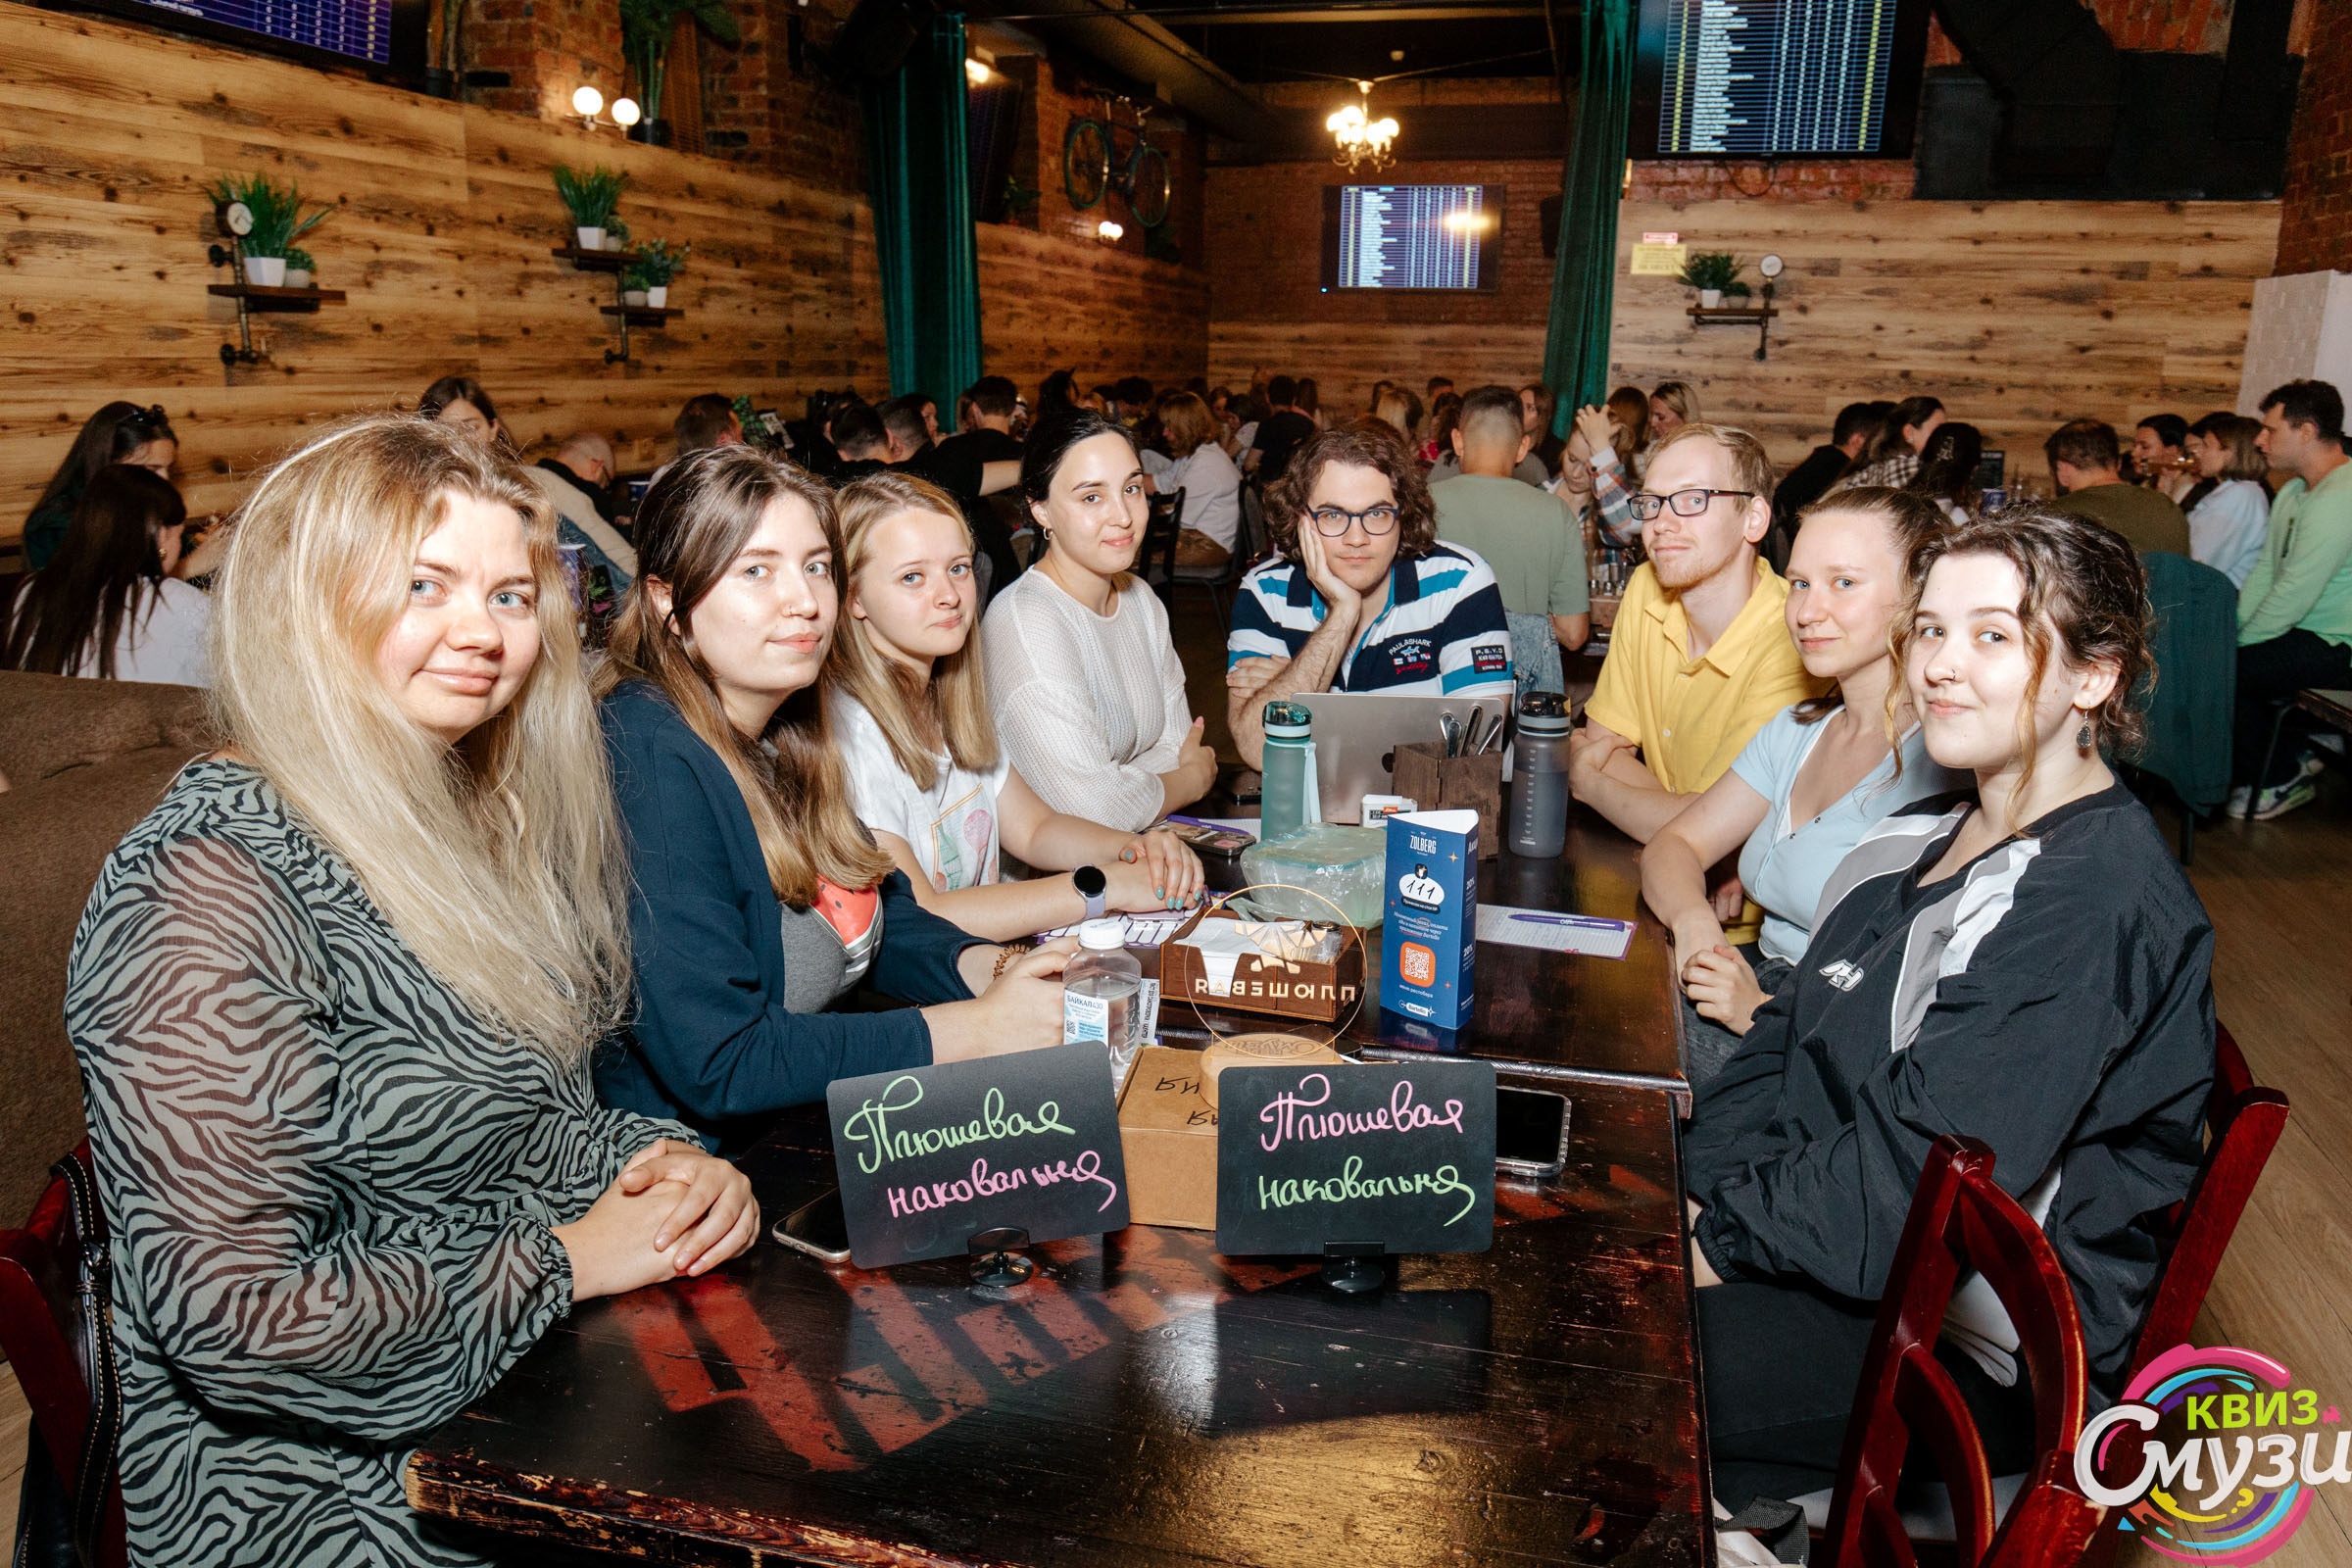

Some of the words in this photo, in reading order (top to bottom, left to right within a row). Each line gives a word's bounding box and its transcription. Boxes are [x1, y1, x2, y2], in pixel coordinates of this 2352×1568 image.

[1409, 835, 1437, 855] ZOLBERG
[1406, 880, 1435, 900] 111
[844, 1075, 1076, 1175] Плюшевая
[1260, 1073, 1464, 1152] Плюшевая
